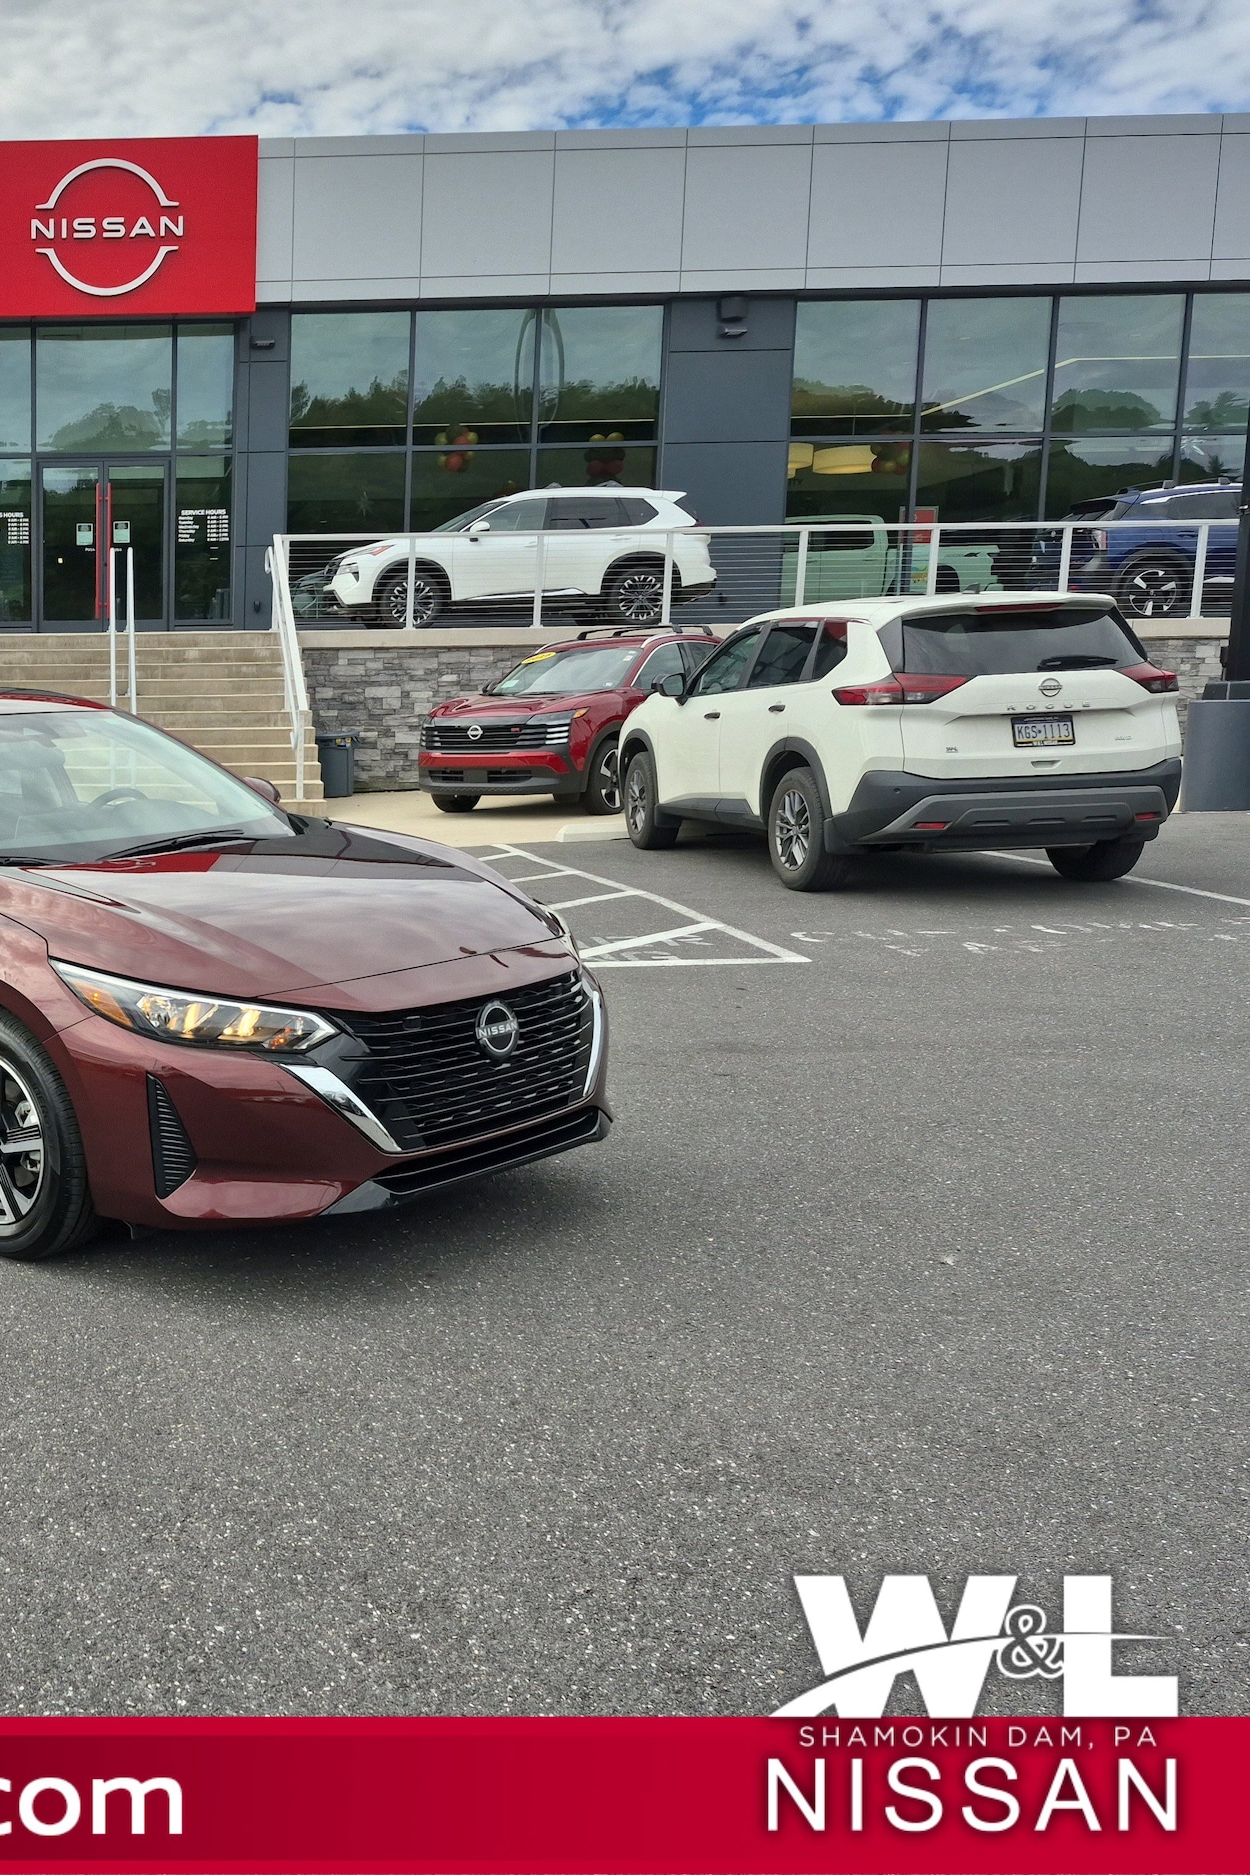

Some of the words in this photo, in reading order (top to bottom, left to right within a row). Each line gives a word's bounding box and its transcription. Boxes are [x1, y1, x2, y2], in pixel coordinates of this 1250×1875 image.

[30, 215, 184, 240] NISSAN
[1006, 701, 1091, 711] ROGUE
[477, 1021, 518, 1037] NISSAN
